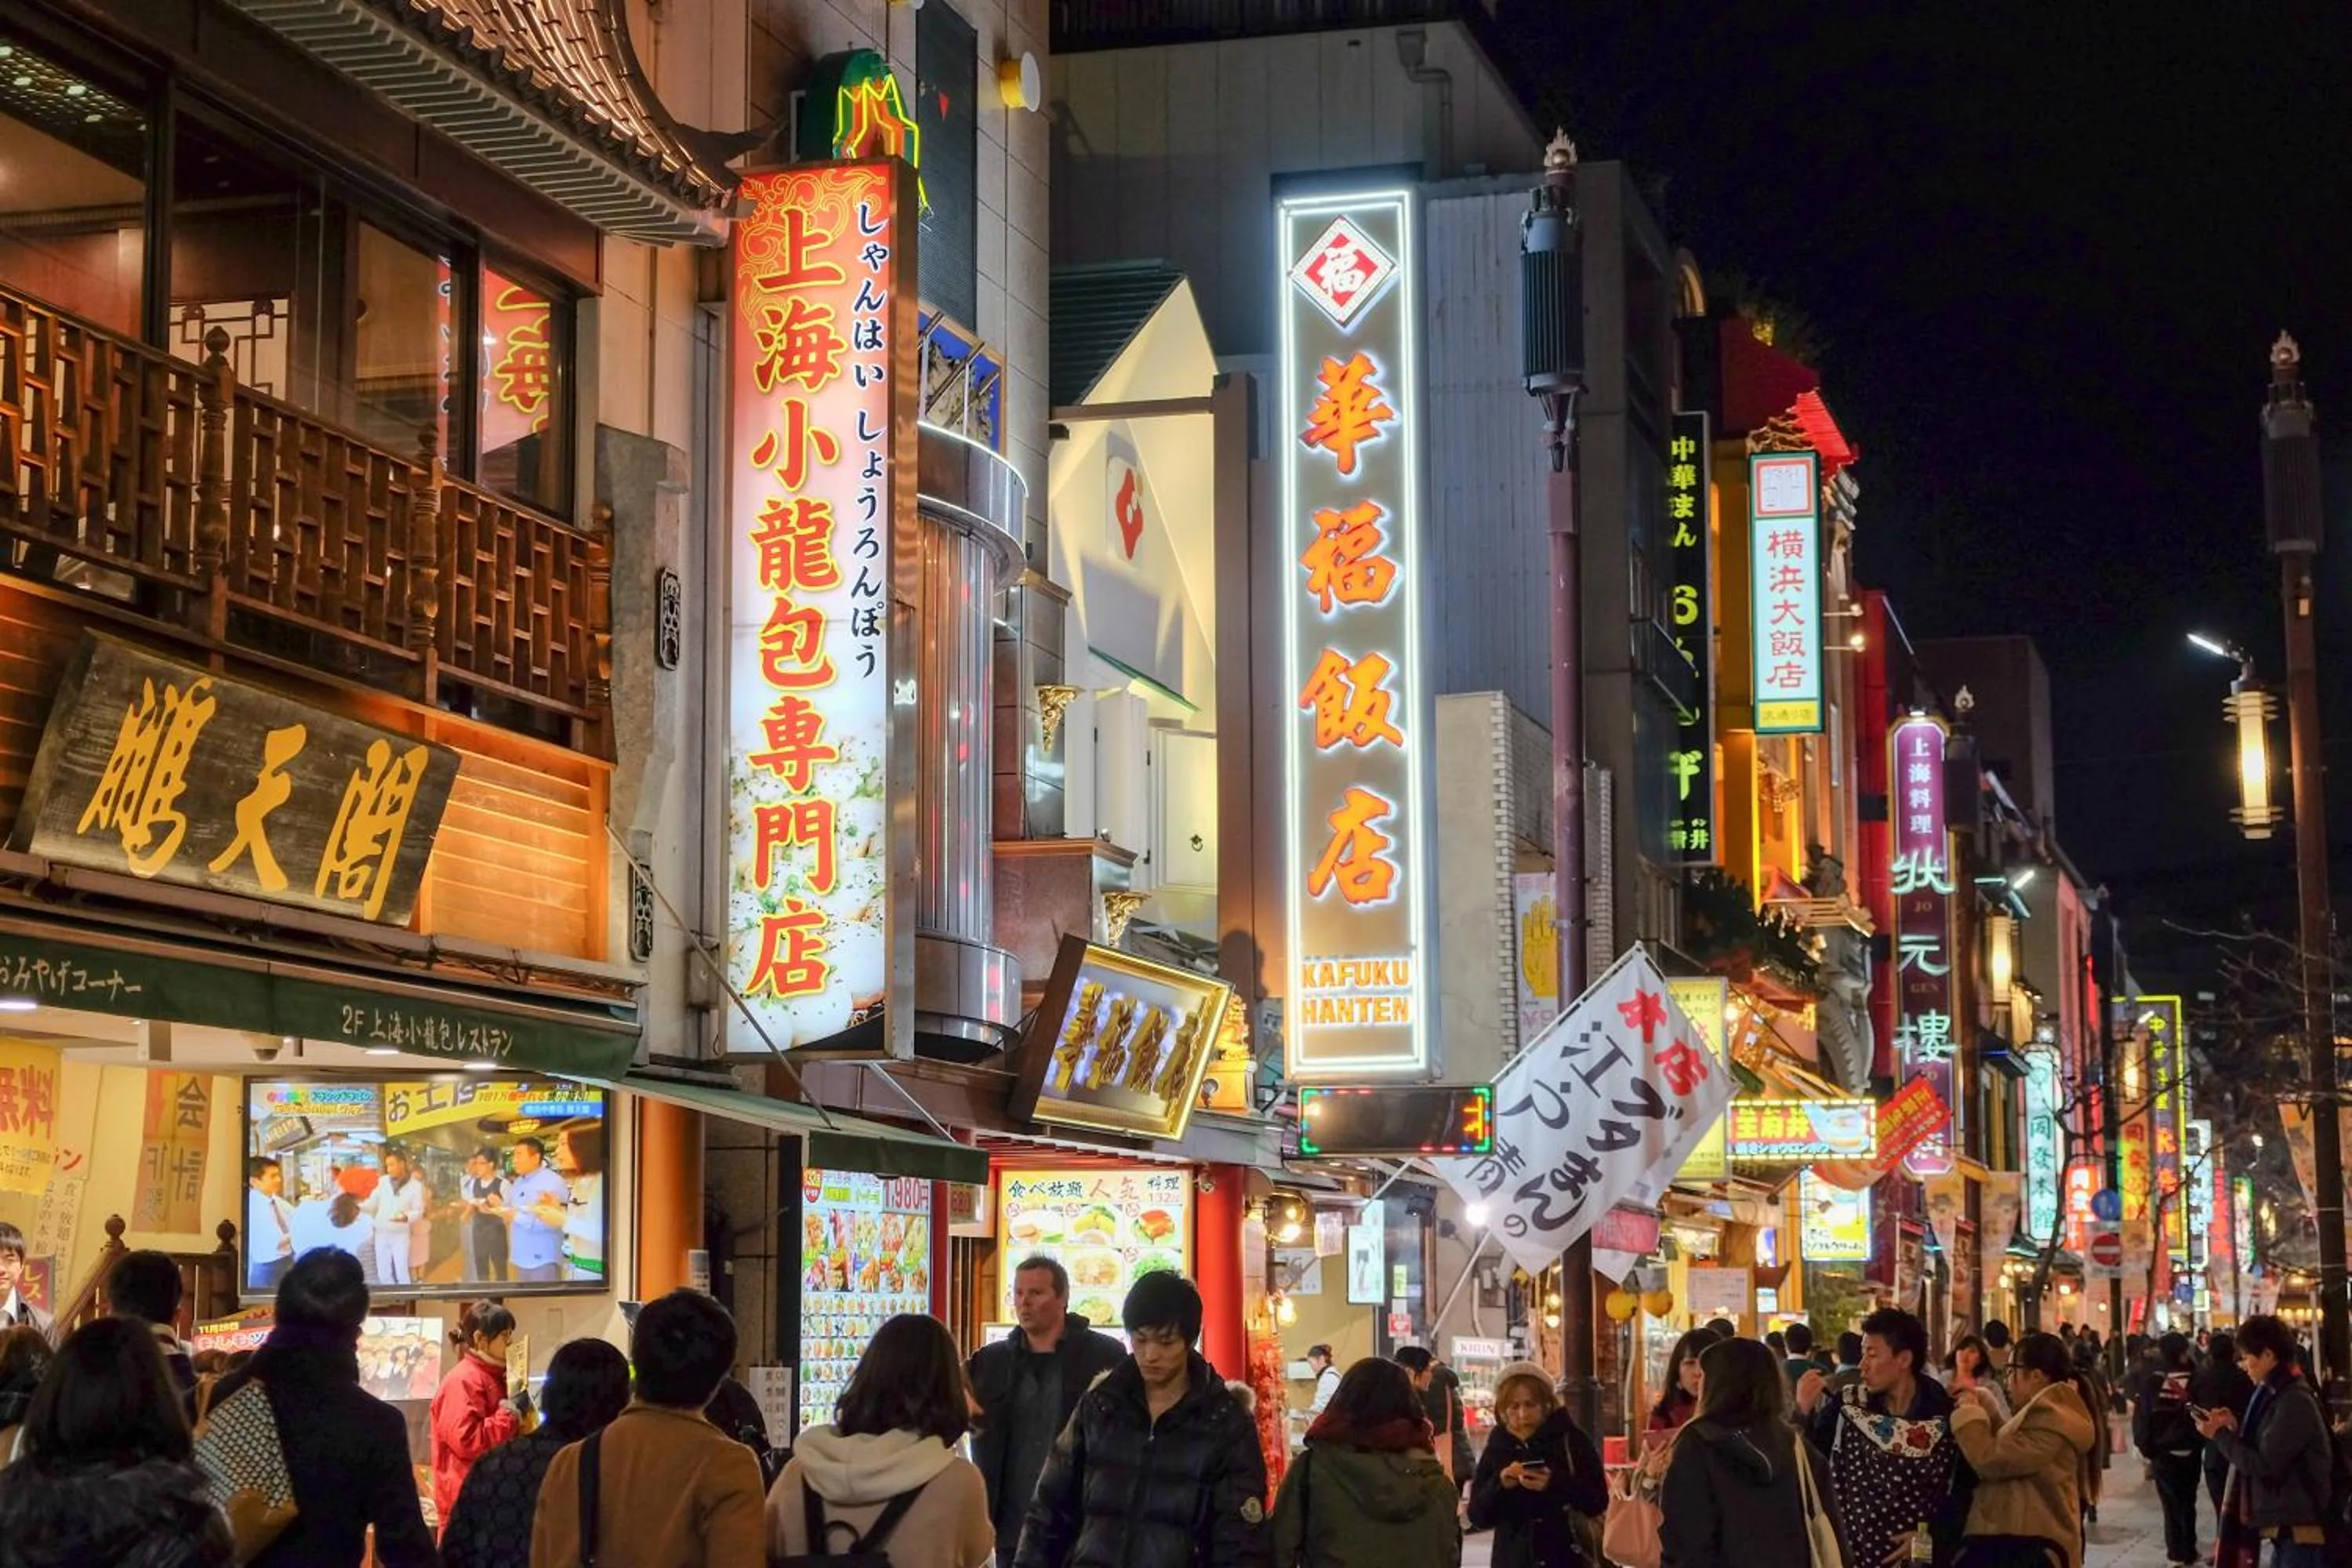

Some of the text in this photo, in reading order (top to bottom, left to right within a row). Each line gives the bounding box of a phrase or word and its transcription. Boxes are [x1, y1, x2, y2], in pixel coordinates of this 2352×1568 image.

[850, 202, 889, 679] しゃんはい しょうろんぽう
[1670, 436, 1697, 548] 中華まん
[746, 207, 846, 996] 上海小龍包専門店
[1298, 350, 1403, 905] 華福飯店
[1766, 529, 1806, 688] 横浜大飯店
[1908, 737, 1933, 835] 上海料理
[342, 1004, 364, 1036] 2F
[1302, 960, 1409, 987] KAFUKU
[1302, 996, 1409, 1023] HANTEN
[1461, 1342, 1495, 1355] KIRIN
